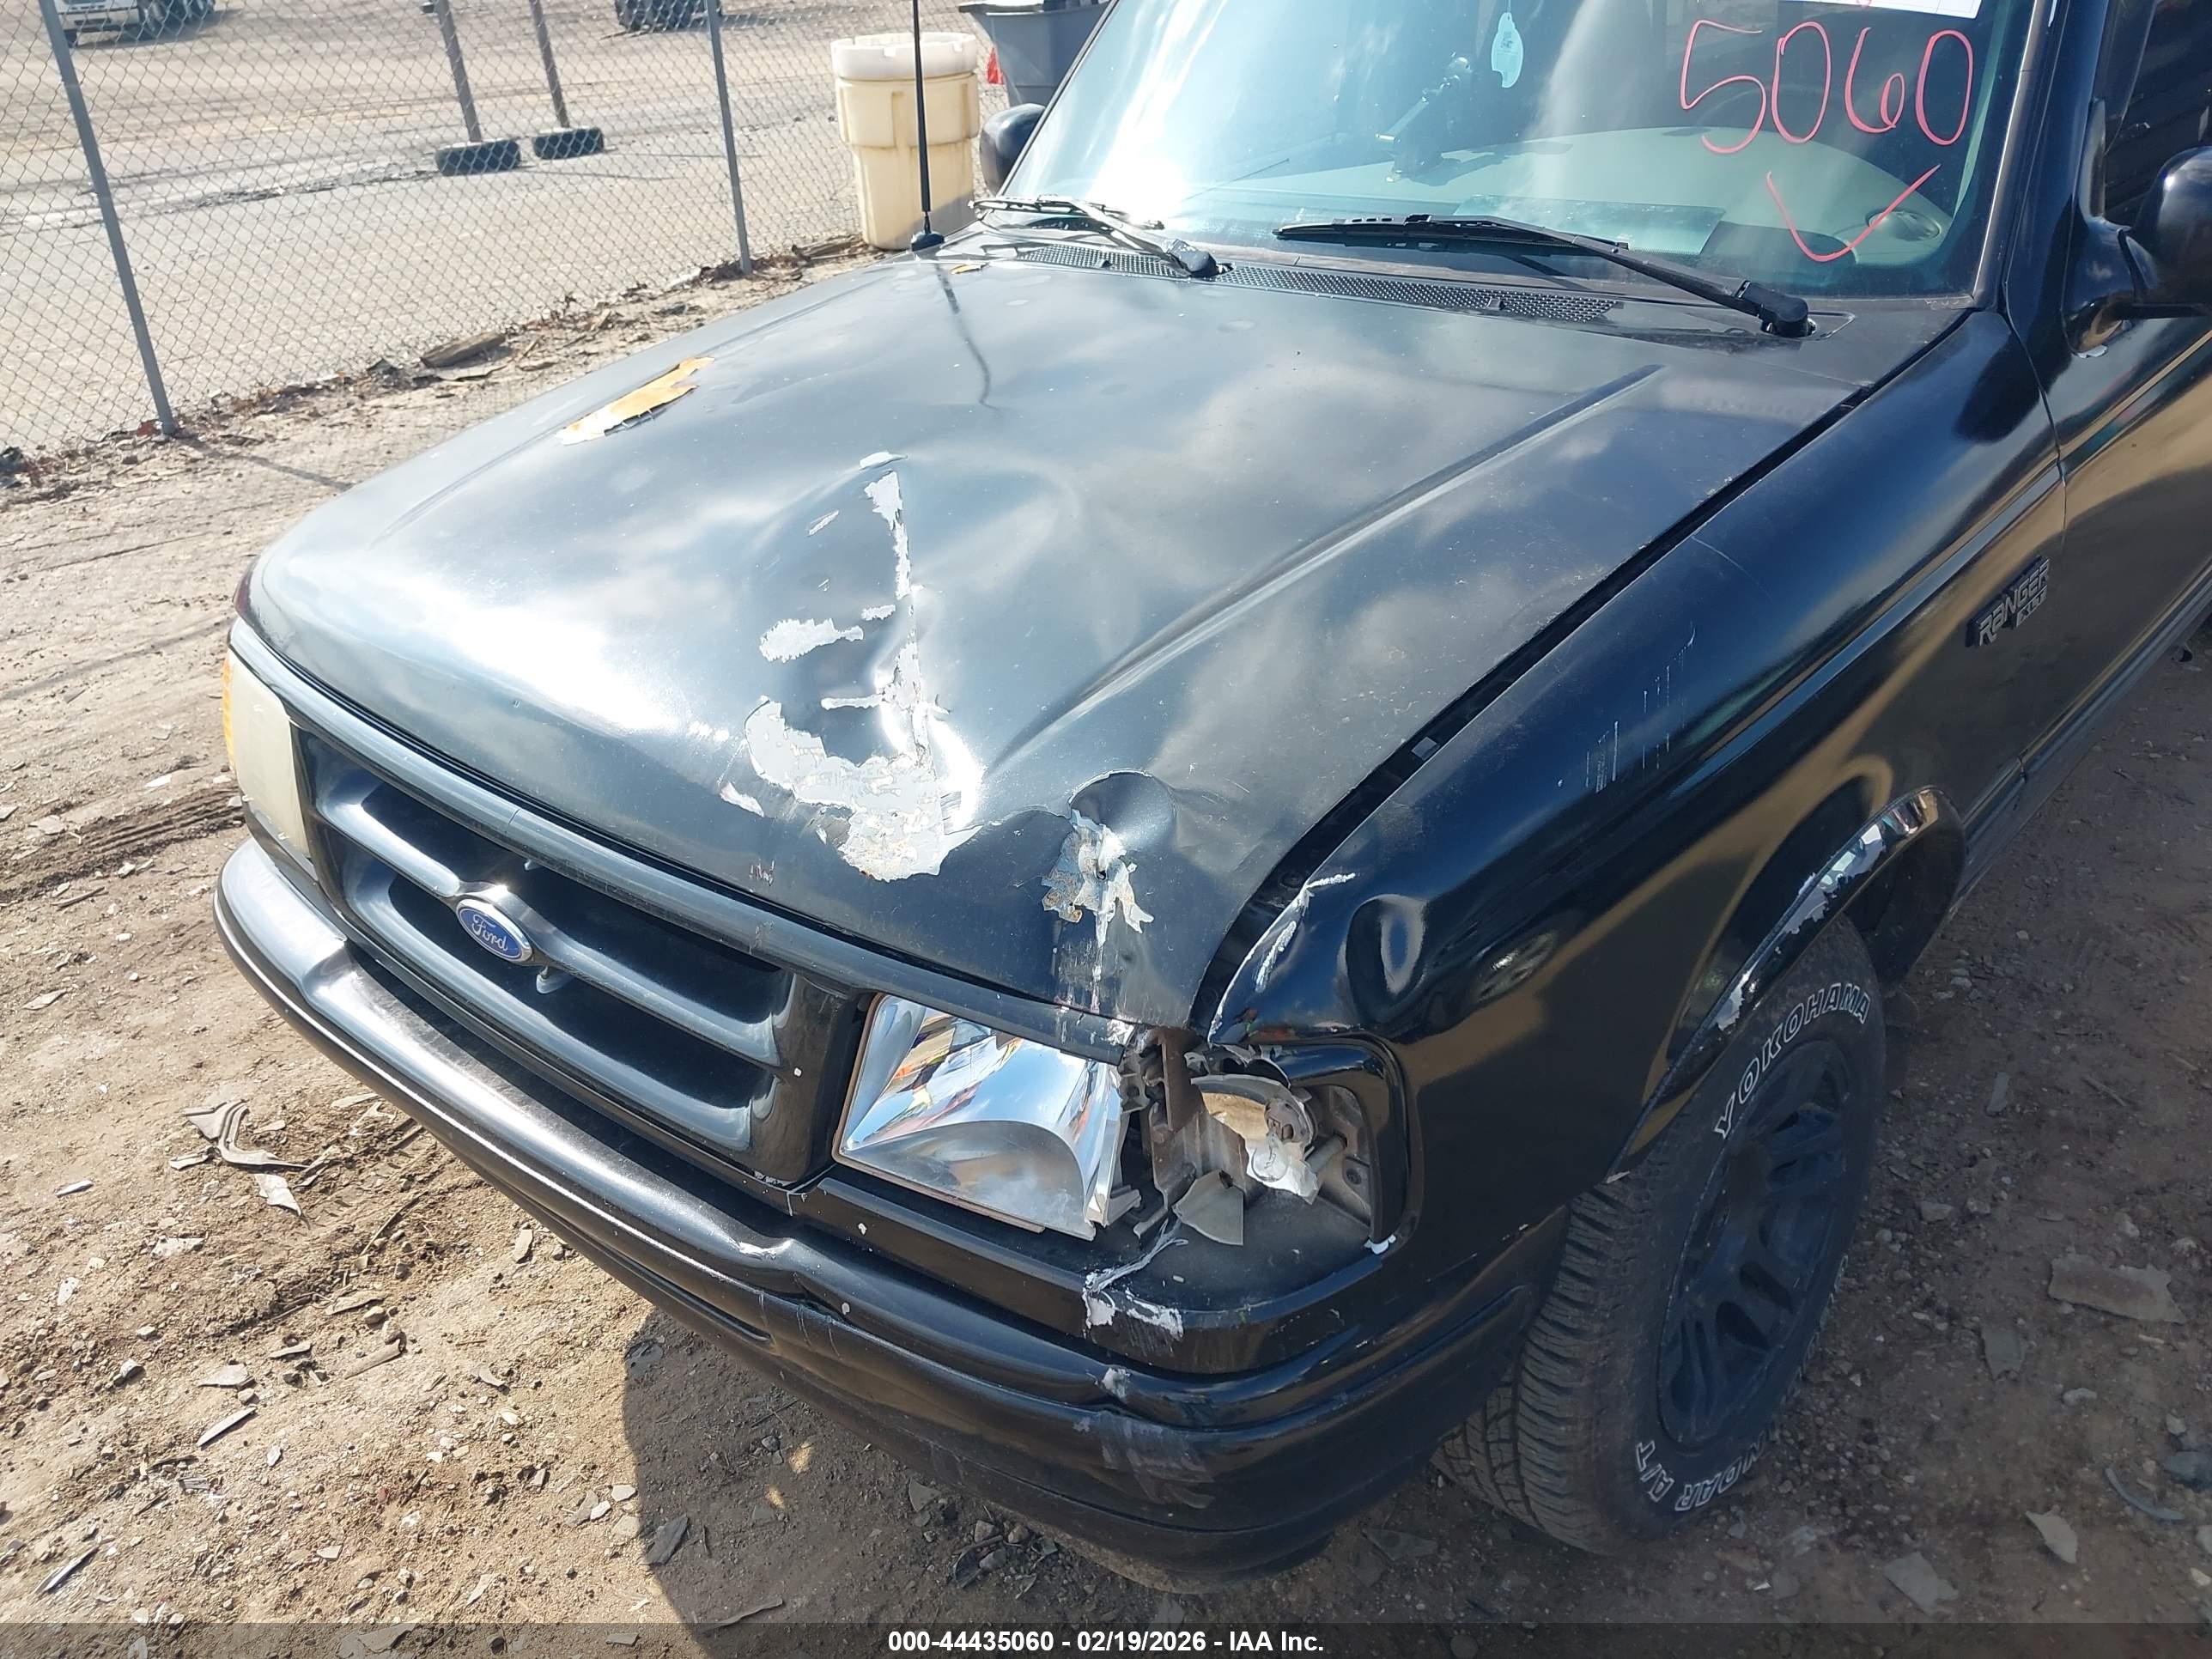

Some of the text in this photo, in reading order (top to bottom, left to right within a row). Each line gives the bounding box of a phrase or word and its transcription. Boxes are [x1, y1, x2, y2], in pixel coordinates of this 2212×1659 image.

[1680, 20, 1973, 155] 5060
[2016, 586, 2048, 627] XLT
[471, 914, 509, 951] Ford
[1714, 982, 1871, 1139] YOKOHAMA
[1635, 1439, 1675, 1503] A/T
